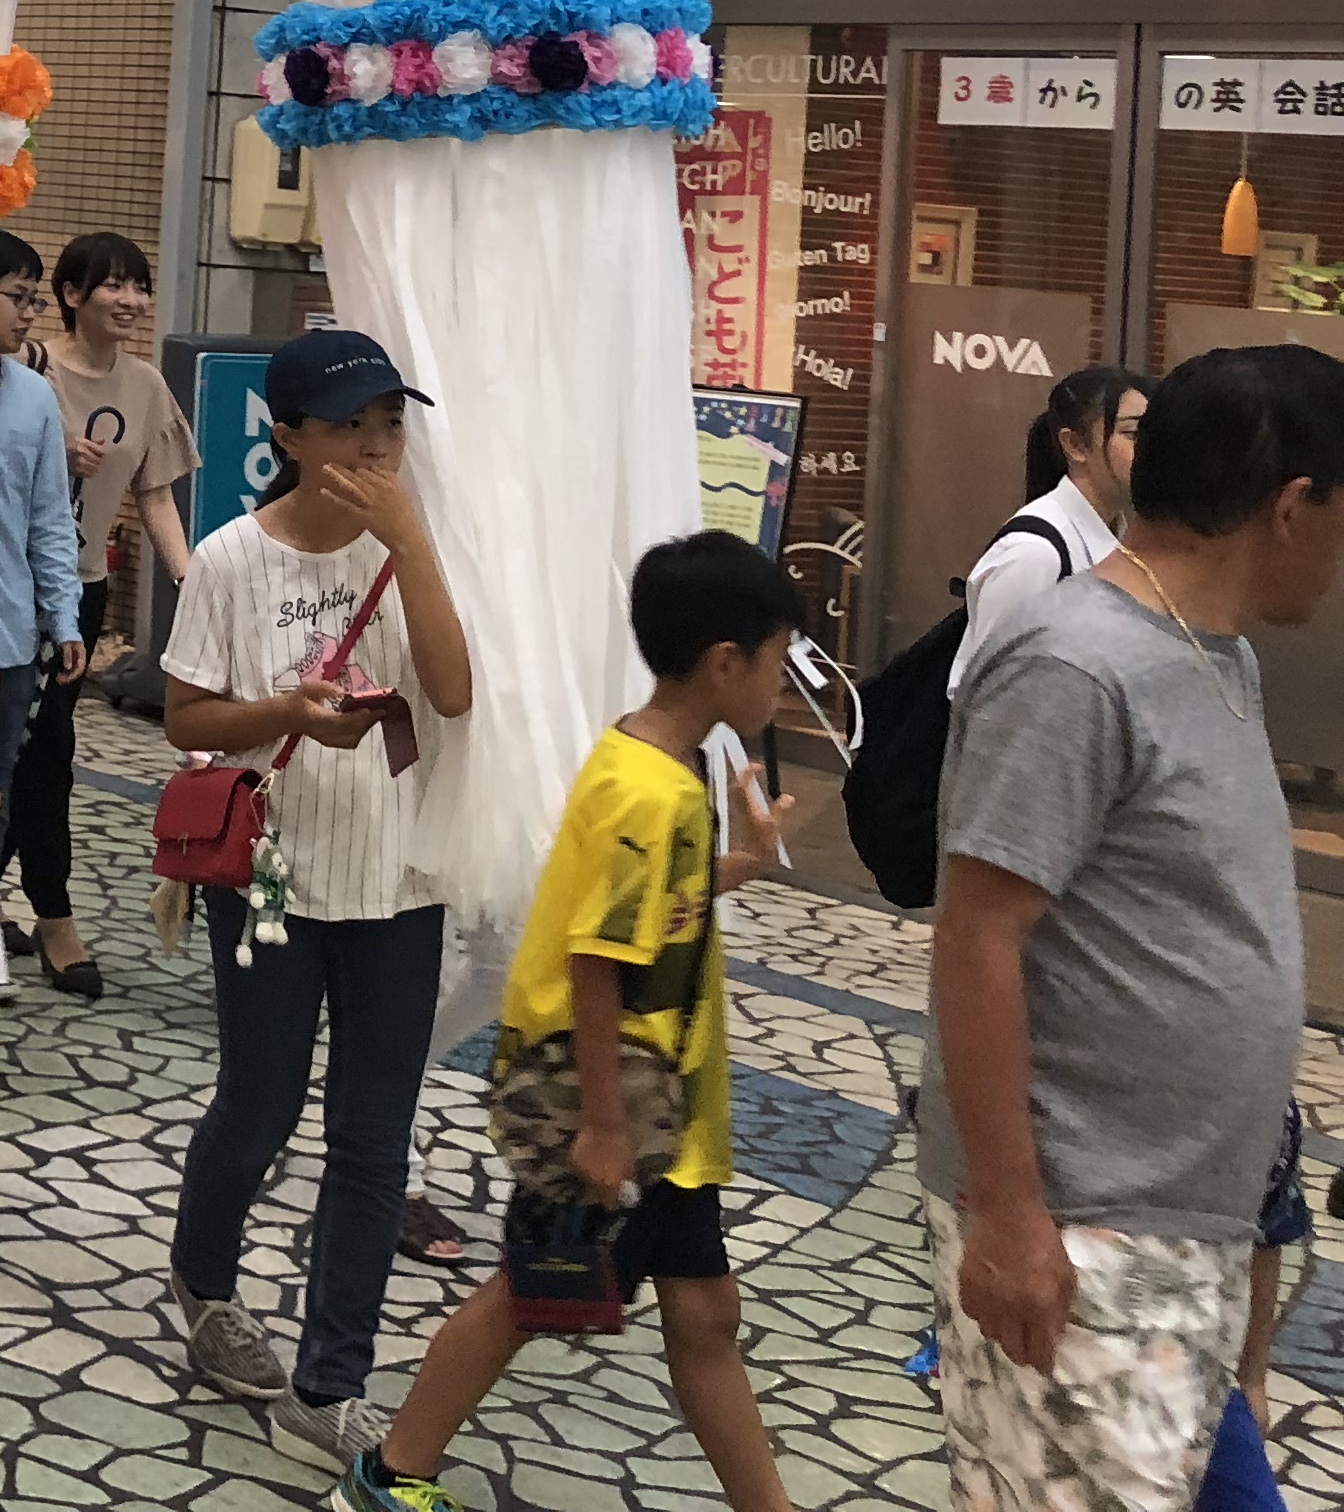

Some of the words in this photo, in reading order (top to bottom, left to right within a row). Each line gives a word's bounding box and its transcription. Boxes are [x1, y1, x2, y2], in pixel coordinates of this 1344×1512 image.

[831, 241, 870, 265] Tag
[793, 344, 854, 390] Hola!
[932, 330, 1054, 378] NOVA
[277, 583, 358, 628] Slightly
